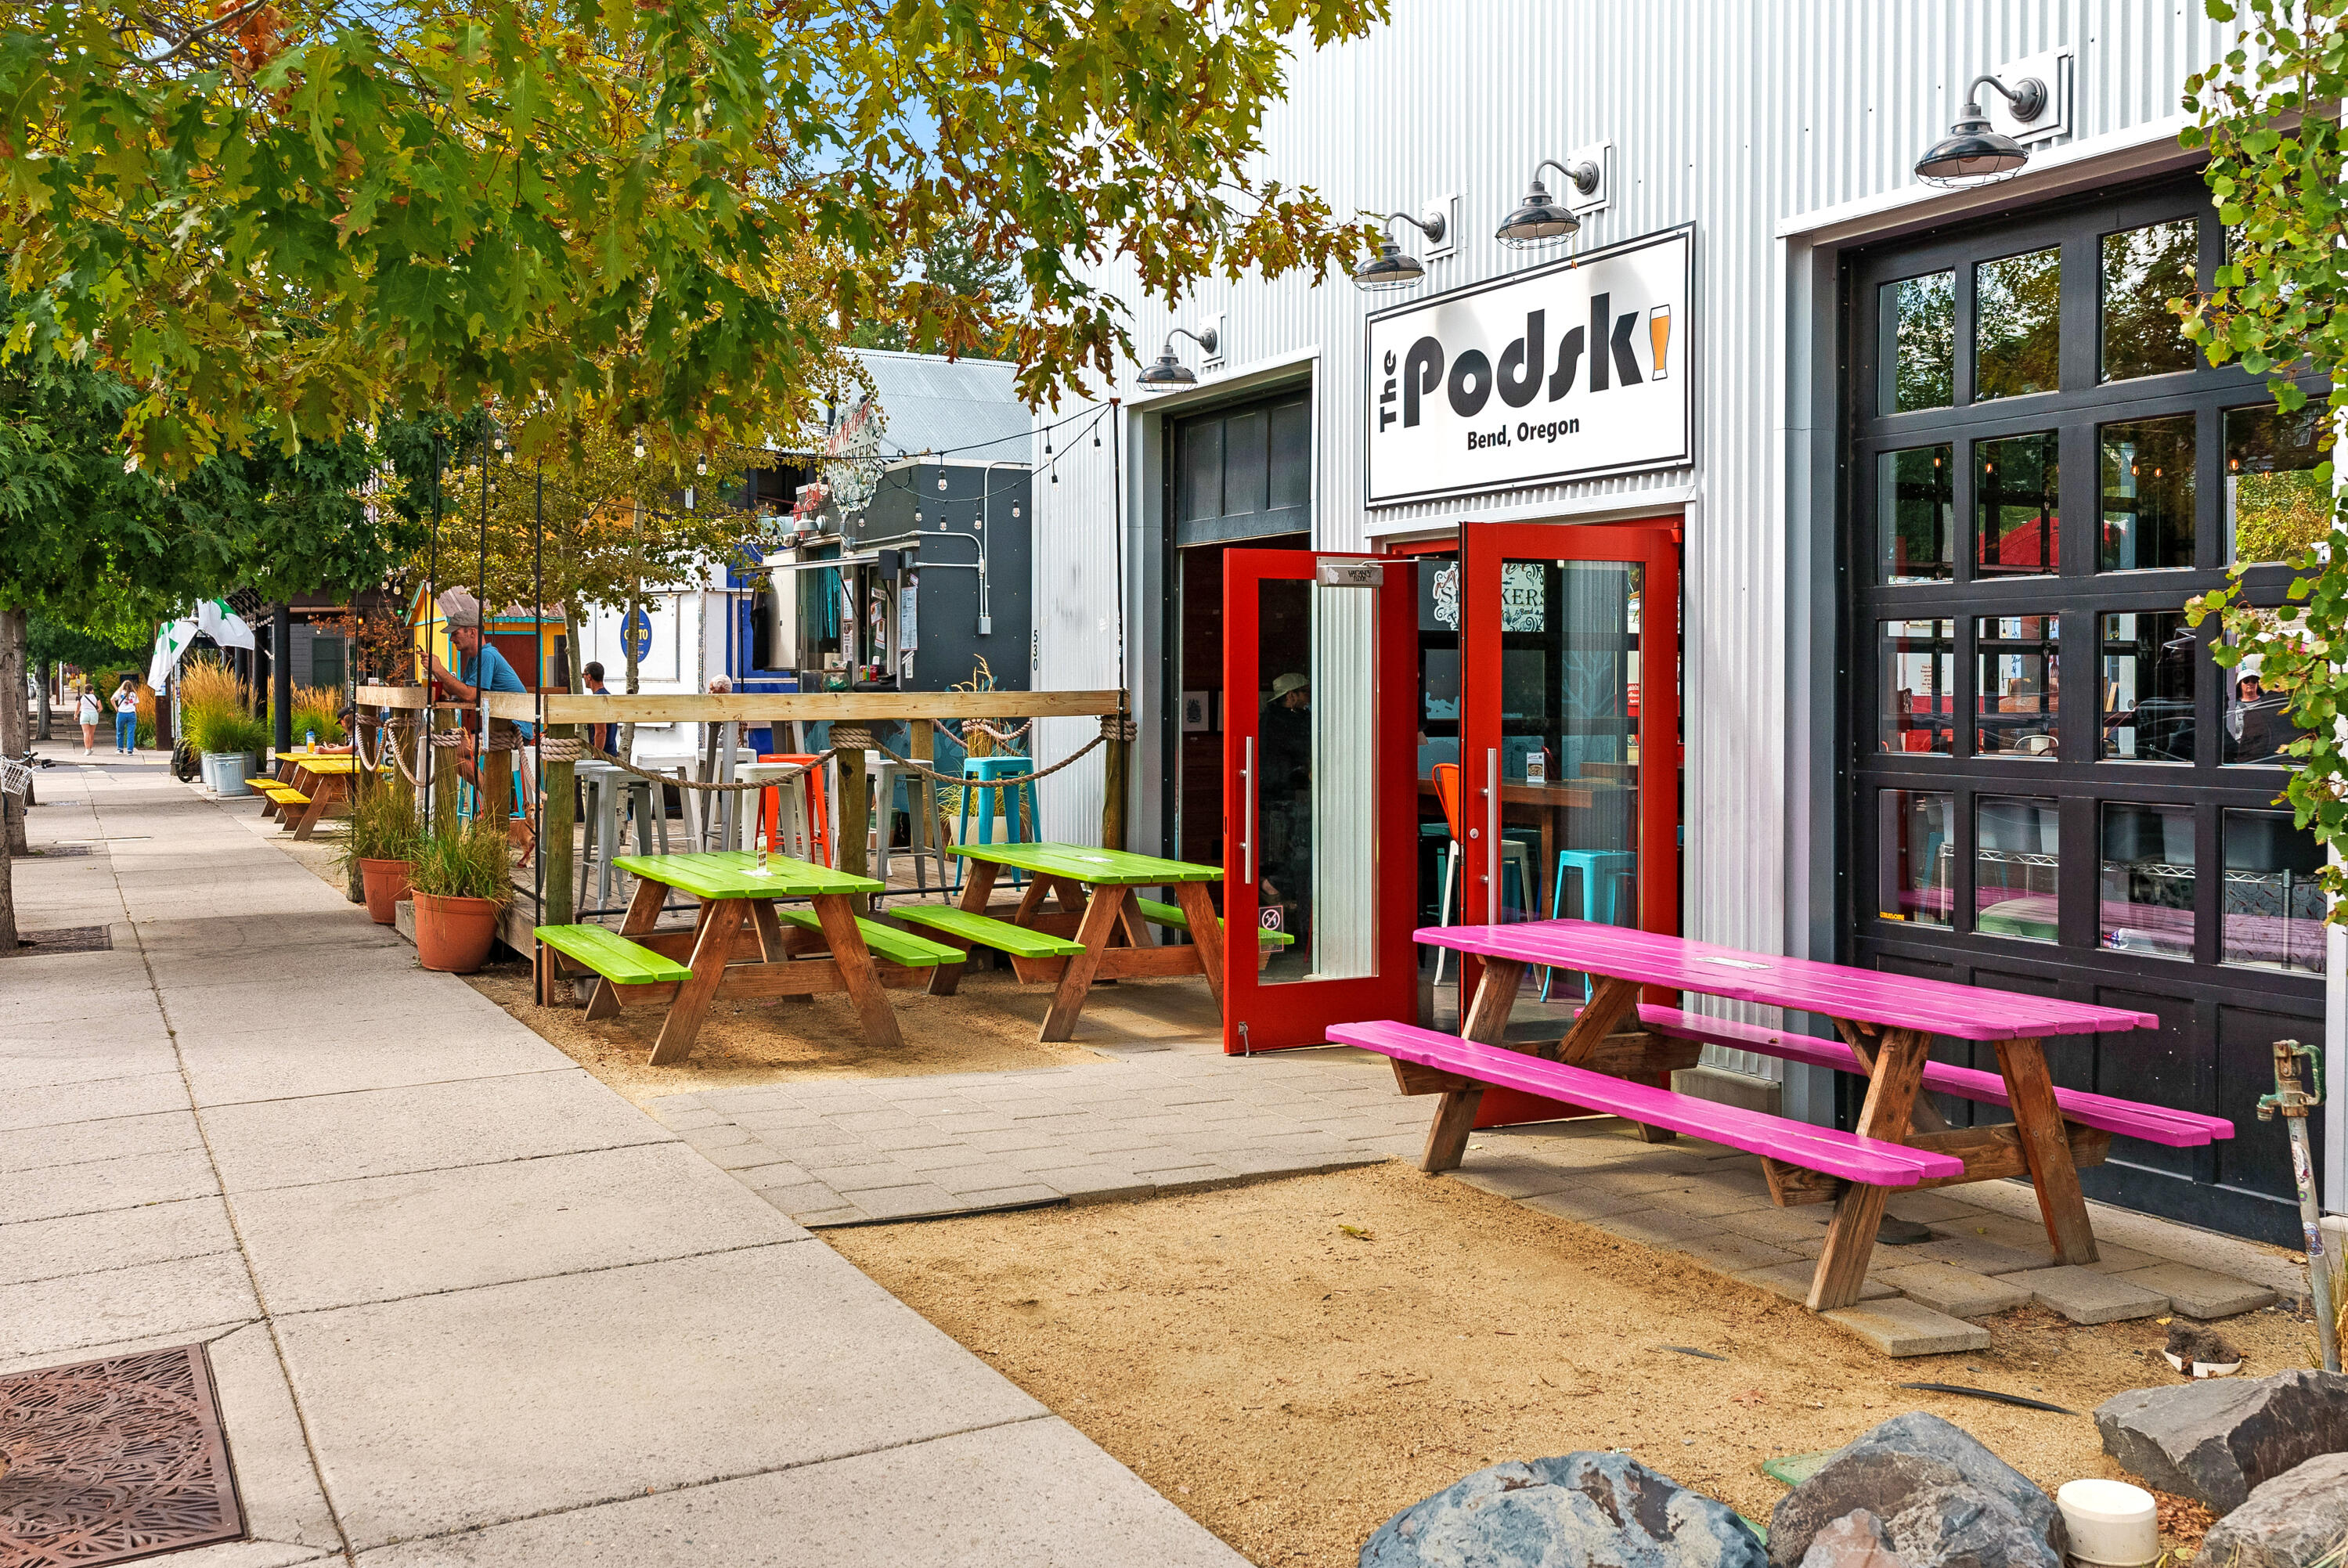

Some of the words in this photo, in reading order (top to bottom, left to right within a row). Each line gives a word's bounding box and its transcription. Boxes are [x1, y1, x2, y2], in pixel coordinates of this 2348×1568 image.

[1380, 349, 1397, 433] The
[1467, 424, 1511, 451] Bend,
[1517, 417, 1580, 444] Oregon
